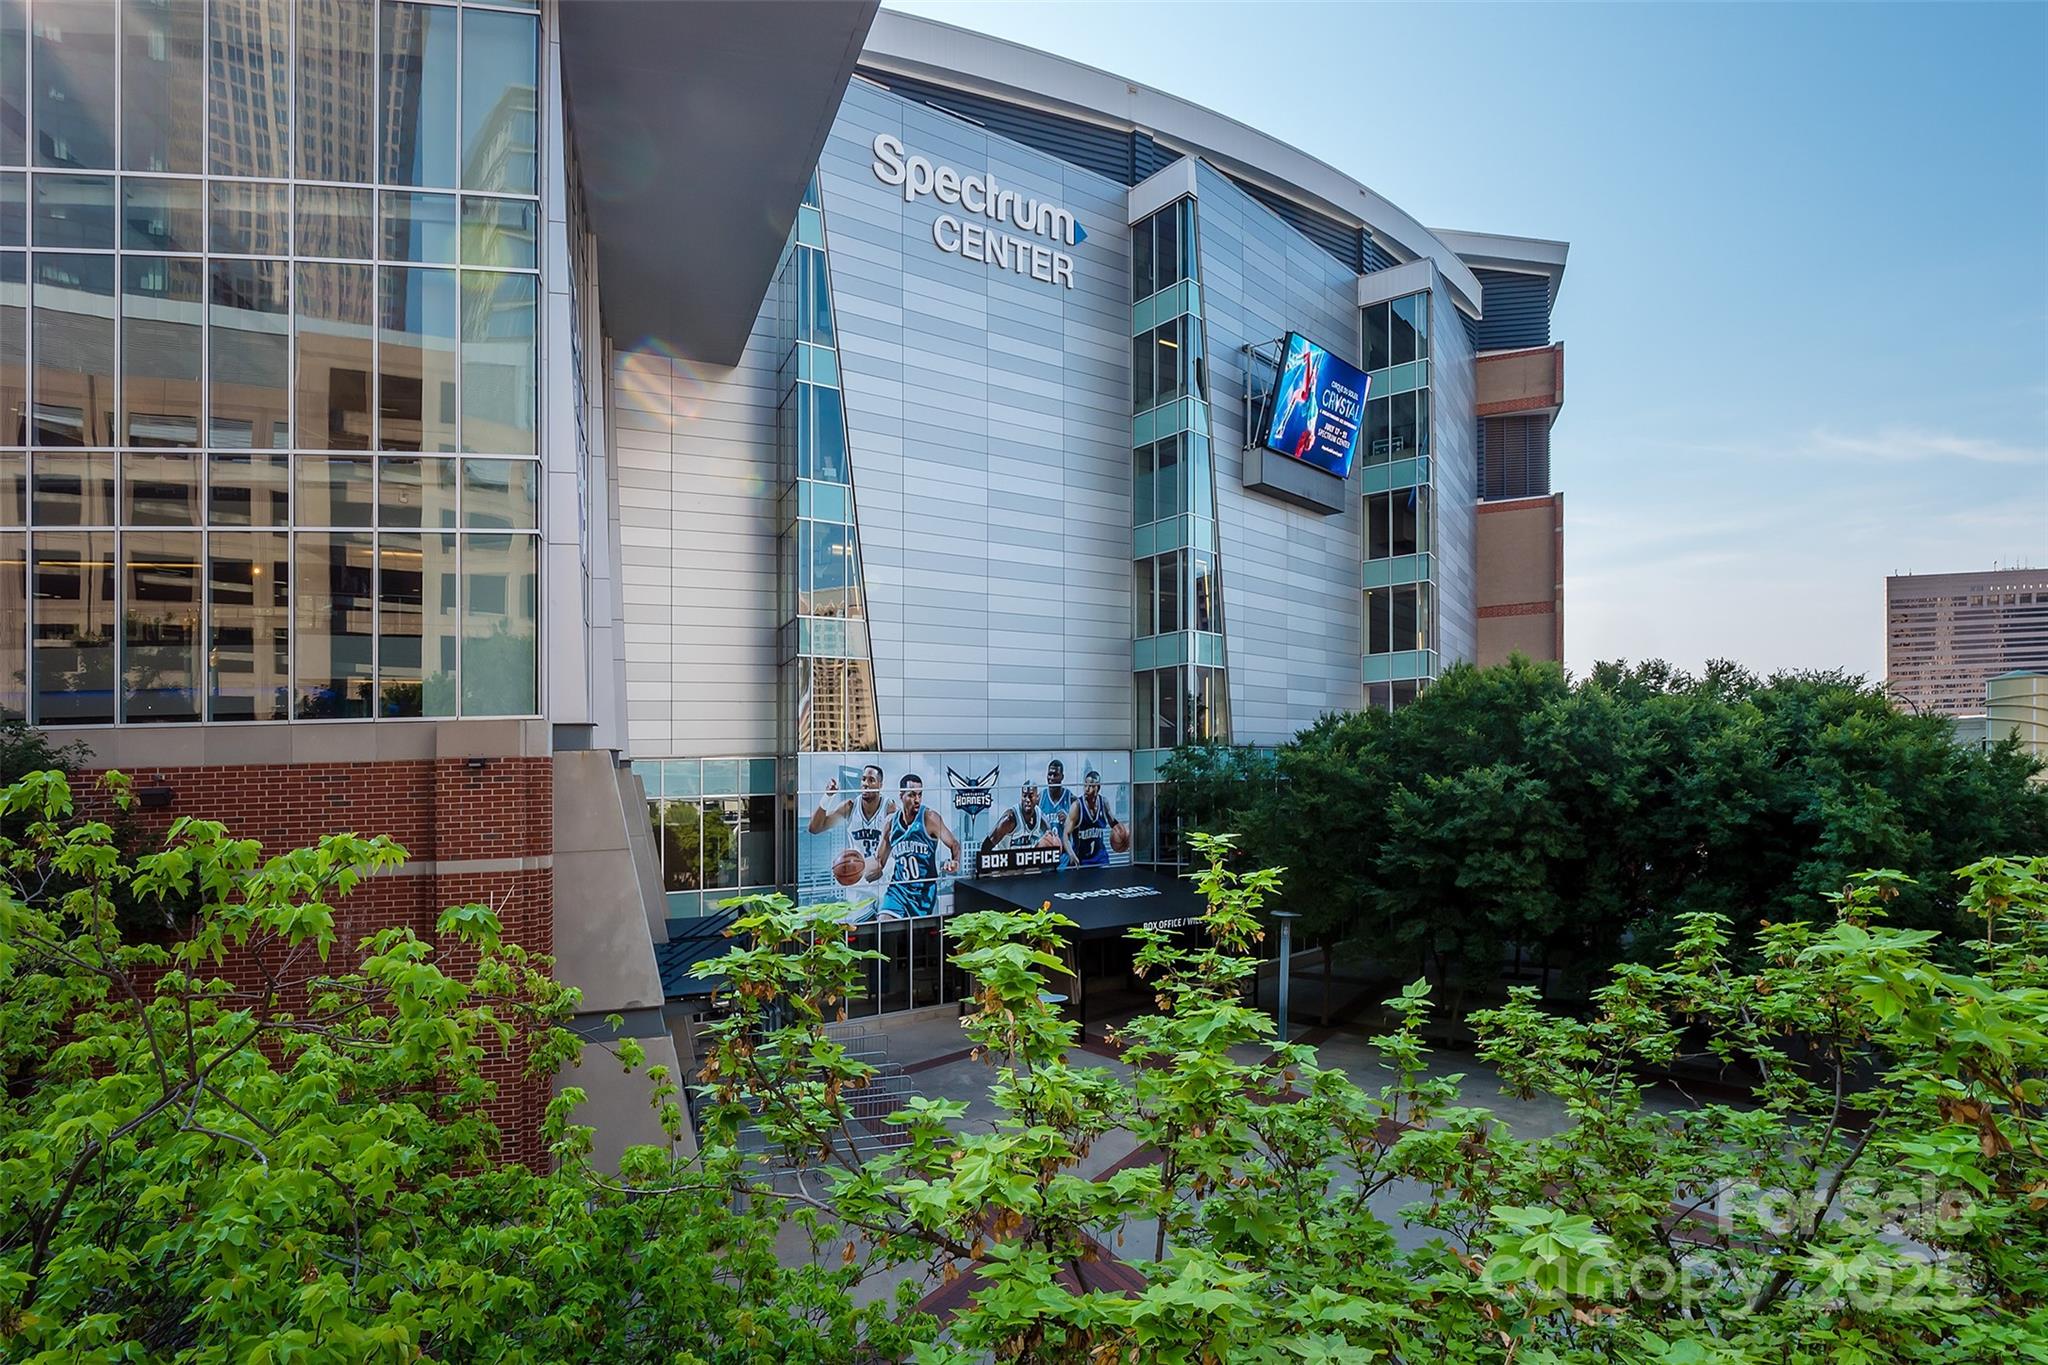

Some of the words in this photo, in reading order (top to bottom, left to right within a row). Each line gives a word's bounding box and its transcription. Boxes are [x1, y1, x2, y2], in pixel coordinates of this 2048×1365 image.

[872, 133, 1075, 245] Spectrum
[932, 214, 1074, 289] CENTER
[1322, 389, 1360, 422] CRYSTAL
[956, 794, 991, 807] HORNETS
[899, 856, 920, 881] 30
[981, 854, 1008, 869] BOX
[1016, 849, 1060, 867] OFFICE
[1053, 885, 1152, 901] Spectrum
[1143, 921, 1158, 931] BOX
[1158, 917, 1182, 929] OFFICE
